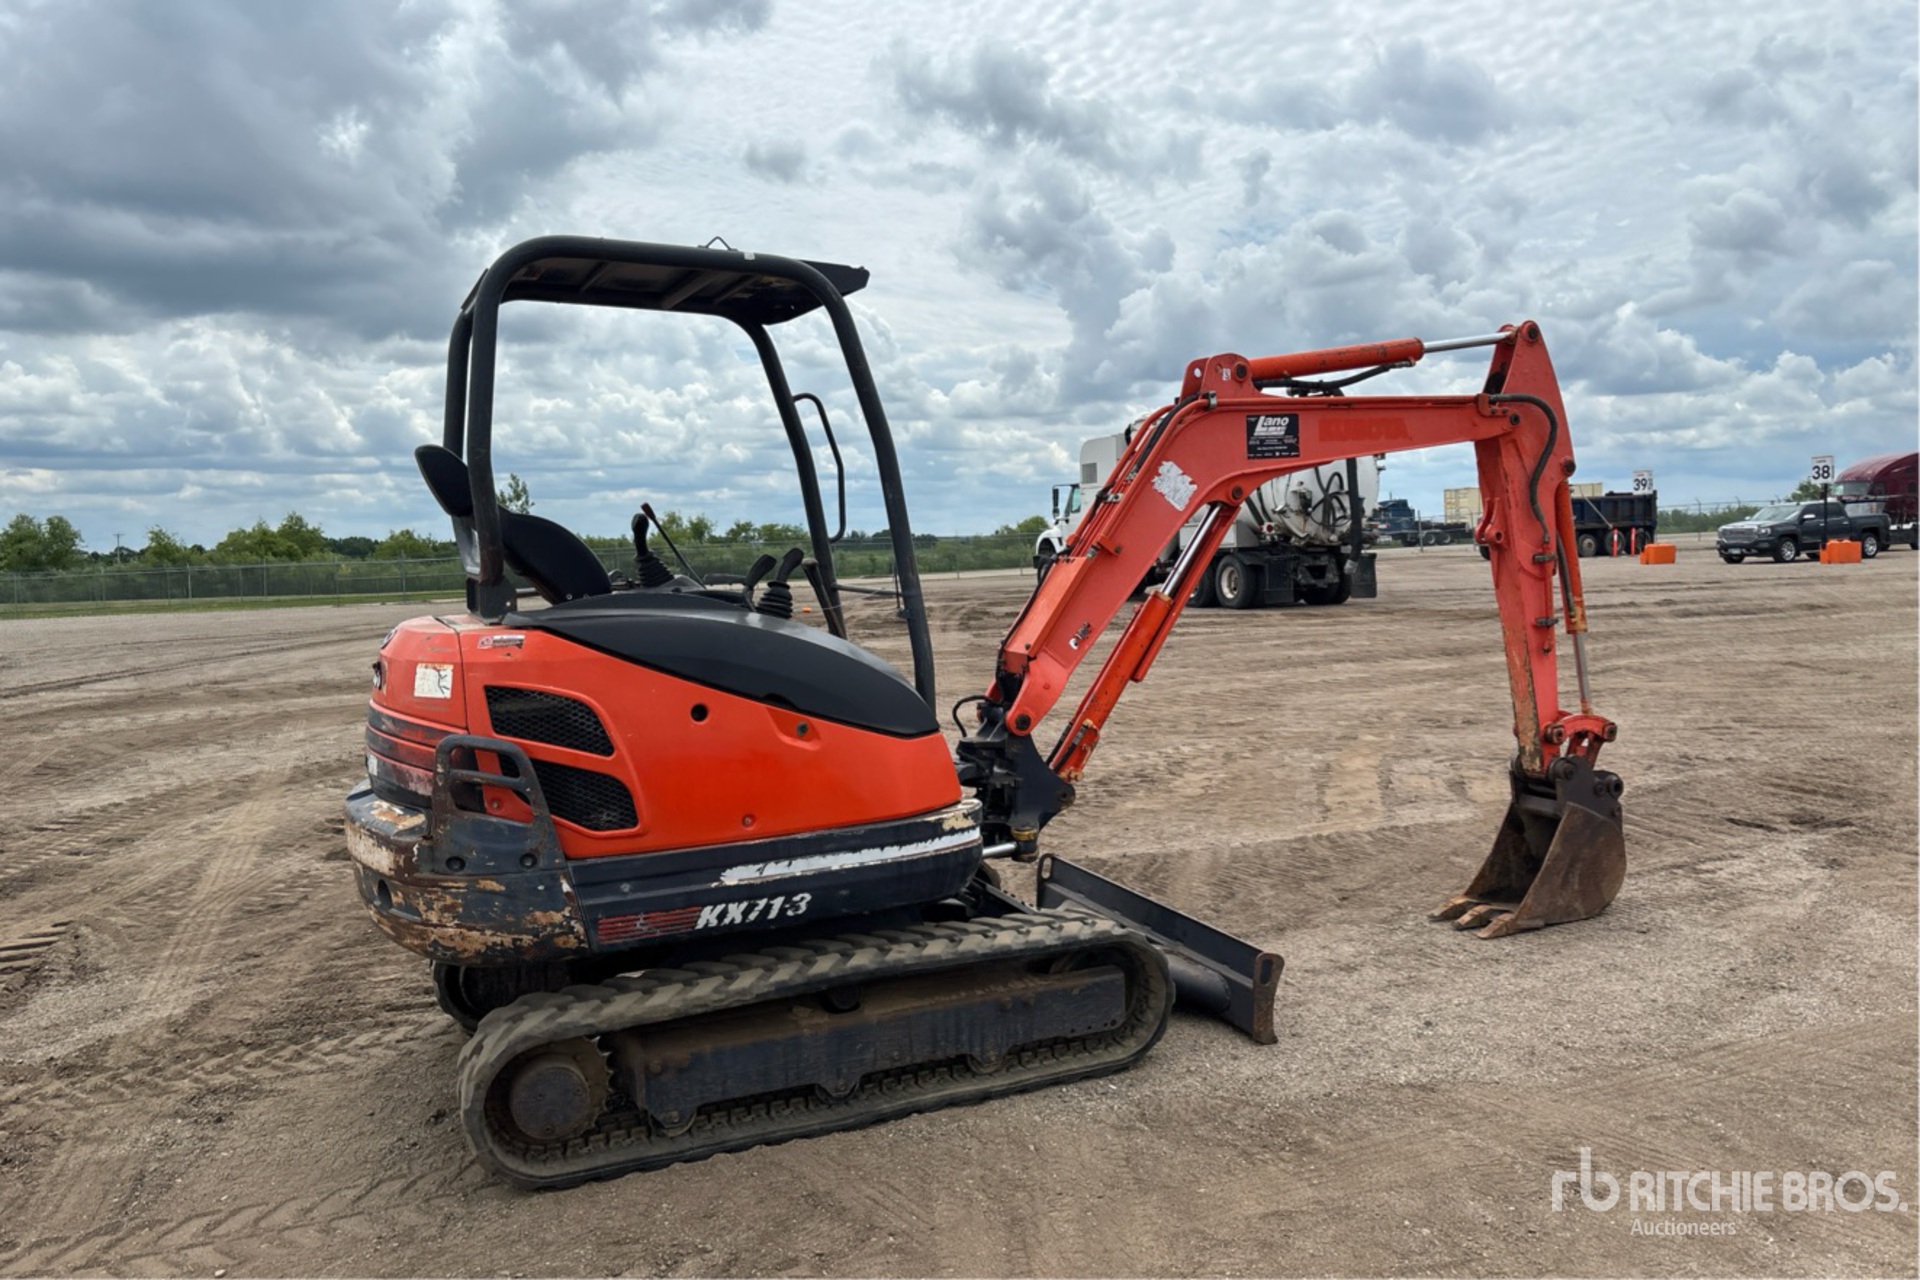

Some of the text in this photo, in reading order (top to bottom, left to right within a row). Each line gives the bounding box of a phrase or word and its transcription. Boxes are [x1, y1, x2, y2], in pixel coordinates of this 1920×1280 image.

[1255, 415, 1289, 432] Lano
[1812, 465, 1831, 480] 38
[1633, 477, 1648, 492] 39
